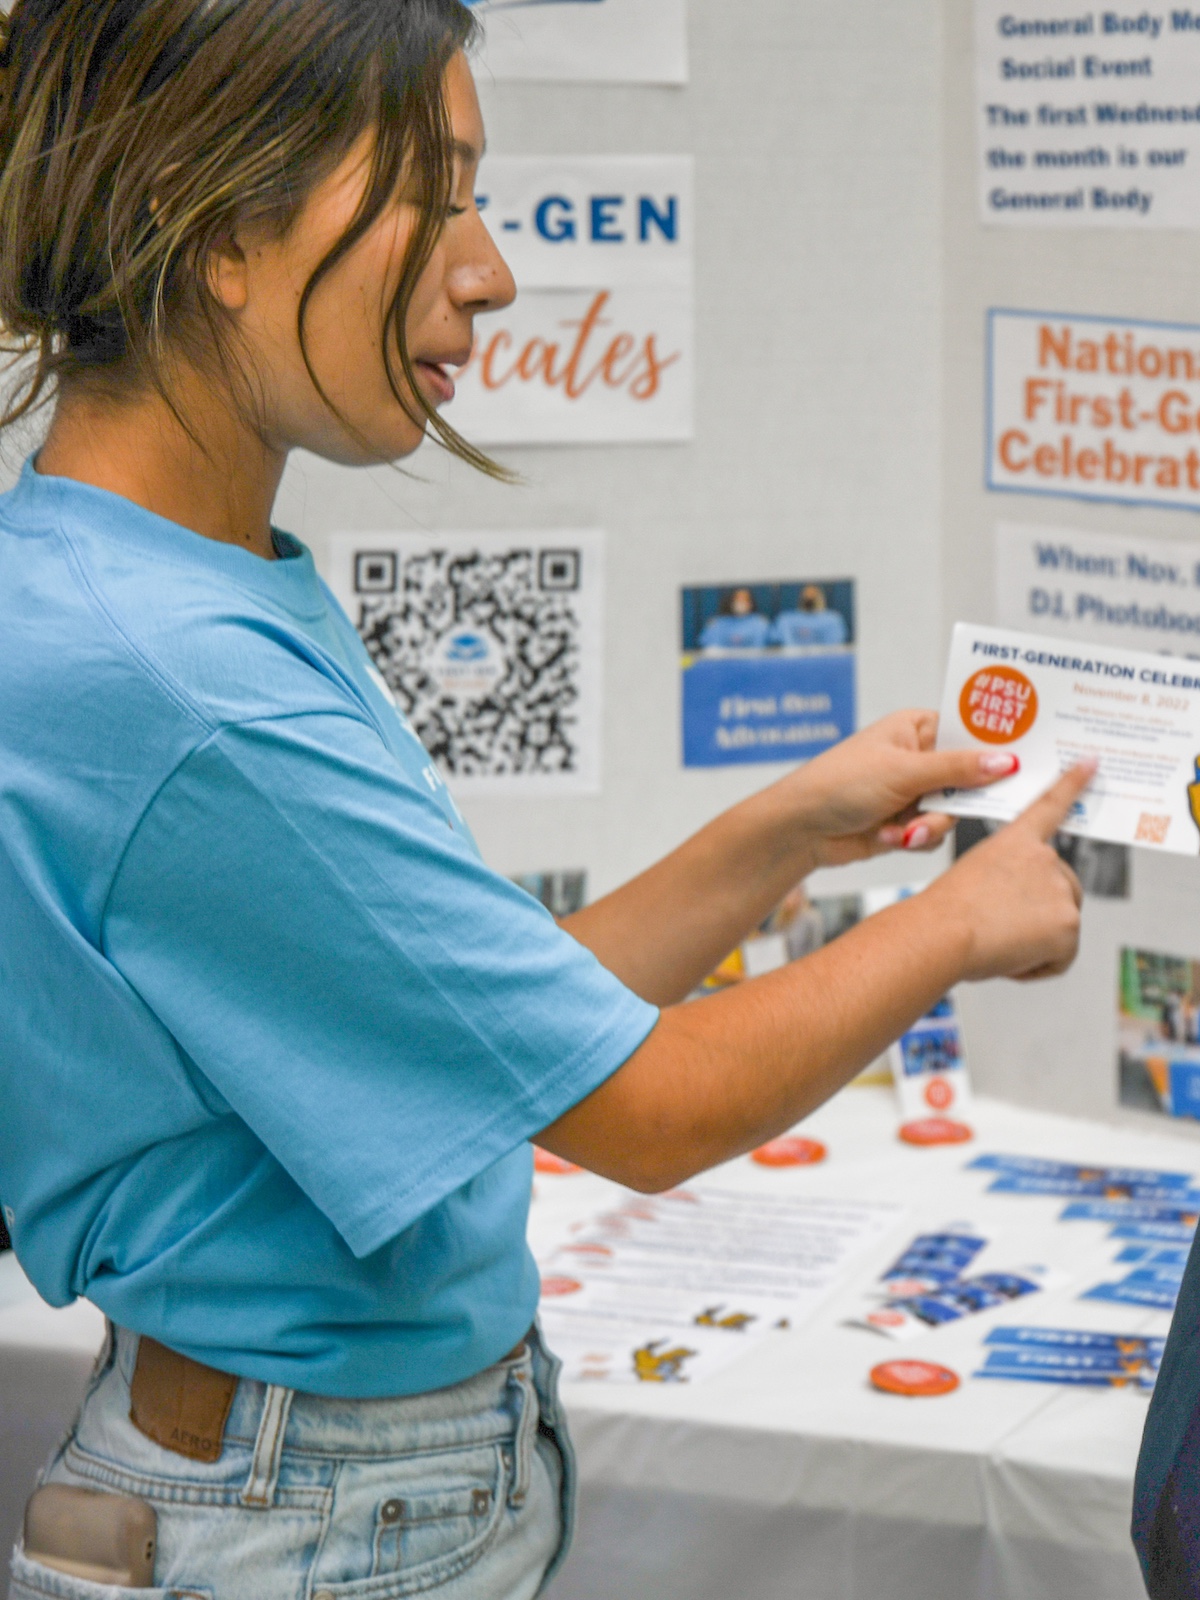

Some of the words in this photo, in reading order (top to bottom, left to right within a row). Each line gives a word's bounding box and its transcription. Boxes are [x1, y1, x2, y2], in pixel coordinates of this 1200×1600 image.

[998, 15, 1094, 37] General
[1102, 12, 1162, 38] Body
[1000, 57, 1075, 80] Social
[1083, 56, 1153, 78] Event
[986, 104, 1028, 126] The
[1037, 103, 1087, 125] first
[987, 147, 1026, 168] the
[1034, 147, 1111, 167] month
[1119, 146, 1139, 167] is
[1147, 149, 1187, 166] our
[989, 188, 1084, 211] General
[1092, 187, 1152, 215] Body
[474, 195, 678, 243] -GEN
[1034, 541, 1119, 575] When:
[1127, 553, 1187, 586] Nov.
[972, 640, 1135, 681] FIRST-GENERATION
[974, 673, 1031, 701] #PSU
[1073, 682, 1138, 704] November
[1158, 695, 1190, 711] 2022
[969, 689, 1027, 719] FIRST
[971, 709, 1015, 736] GEN
